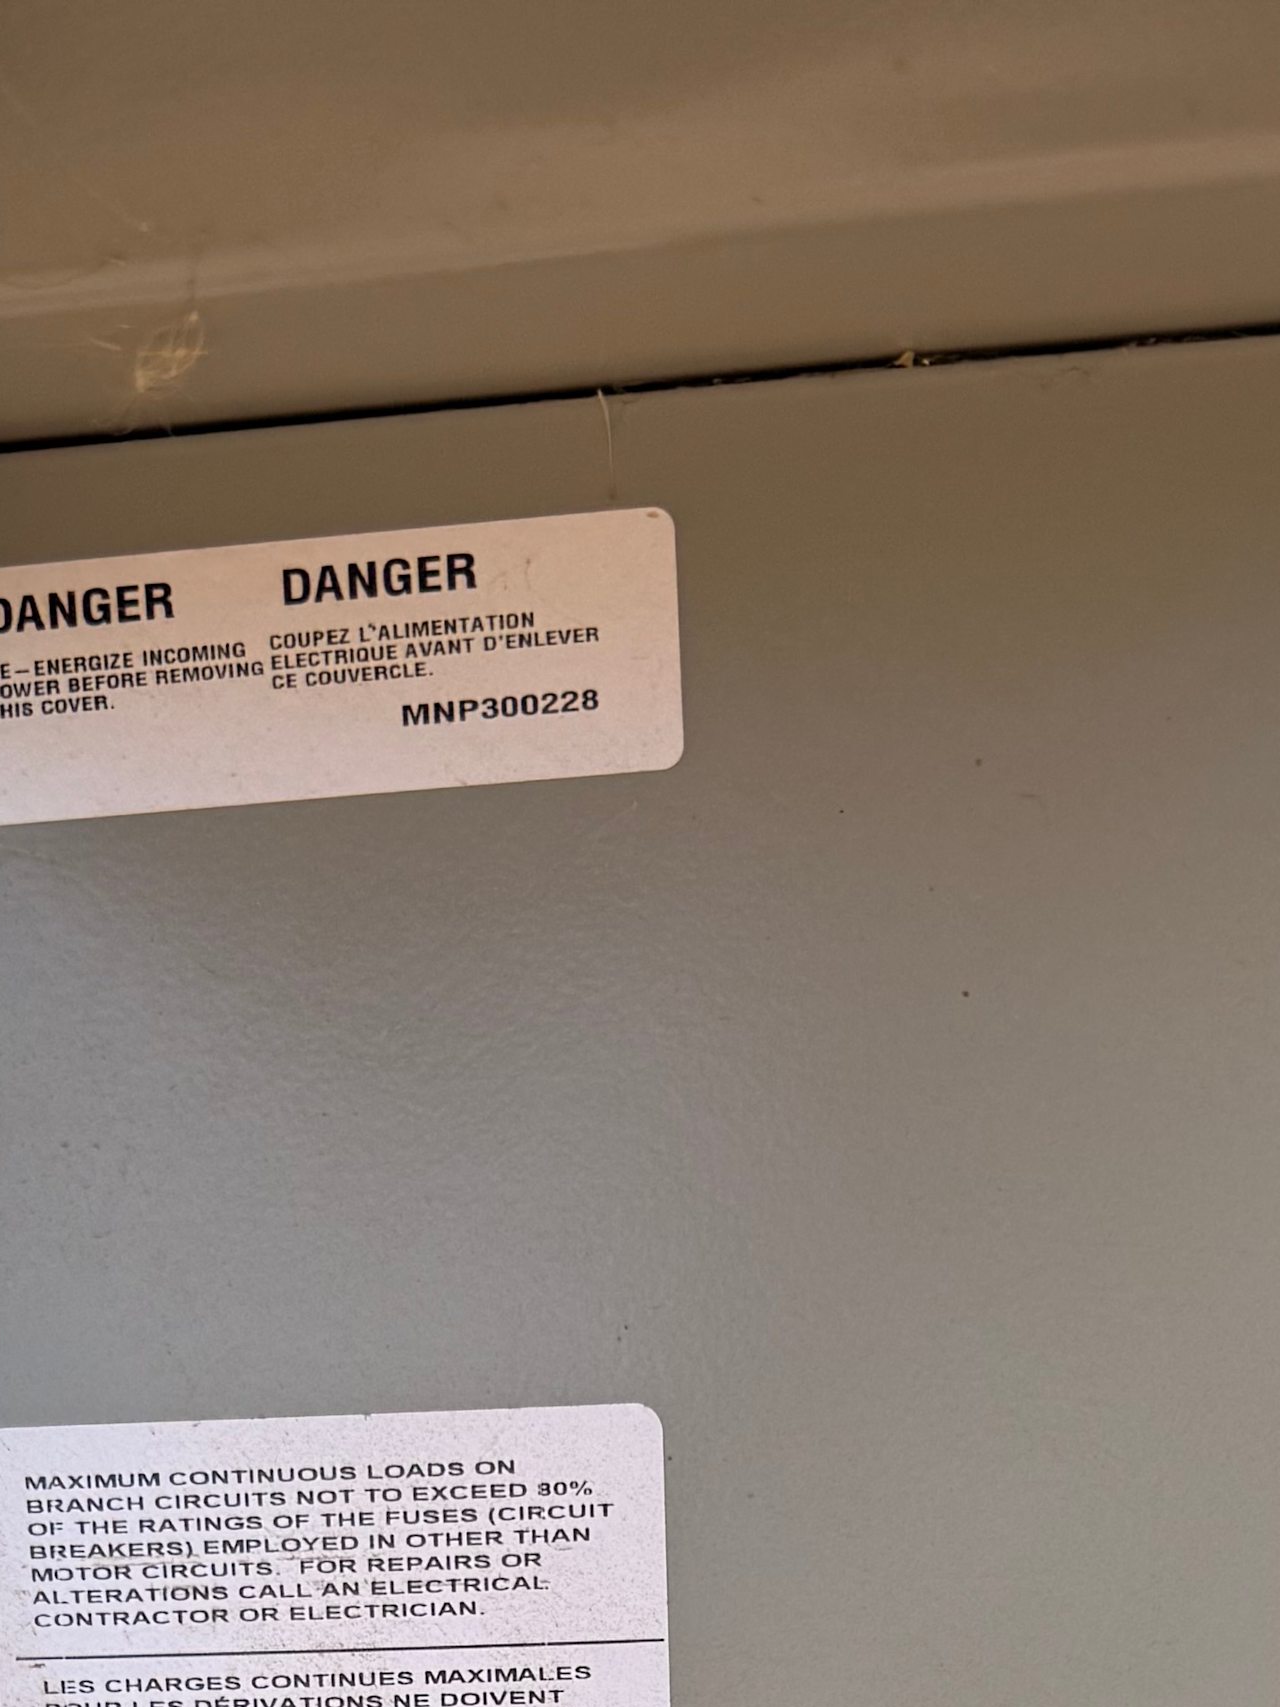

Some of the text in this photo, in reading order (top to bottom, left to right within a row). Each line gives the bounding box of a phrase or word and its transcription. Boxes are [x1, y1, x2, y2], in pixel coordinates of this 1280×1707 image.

[281, 552, 477, 606] DANGER
[142, 641, 245, 666] INCOMING
[269, 627, 350, 650] COUPEZ
[270, 644, 397, 670] ELECTRIQUE
[405, 637, 474, 658] AVANT
[68, 671, 147, 692] BEFORE
[155, 660, 264, 685] REMOVING
[271, 661, 433, 689] CE COUVERCLE.
[40, 694, 114, 715] COVER.
[401, 688, 599, 726] MNP300228
[24, 1459, 515, 1490] MAXIMUM CONTINUOUS LOADS ON
[26, 1482, 527, 1513] BRANCH CIRCUITS NOT TO EXCEED
[27, 1502, 614, 1536] OF THE RATINGS OF THE FUSES (CIRCUIT
[29, 1526, 590, 1561] BREAKERS) EMPLOYED IN OTHER THAN
[31, 1551, 542, 1582] MOTOR CIRCUITS. FOR REPAIRS OR
[32, 1575, 547, 1604] ALTERATIONS CALL AN ELECTRICAL
[33, 1600, 485, 1627] CONTRACTOR OR ELECTRICIAN.
[43, 1665, 591, 1694] LES CHARGES CONTINUES MAXIMALES
[393, 1693, 430, 1707] NE
[440, 1689, 564, 1707] DOIVENT
